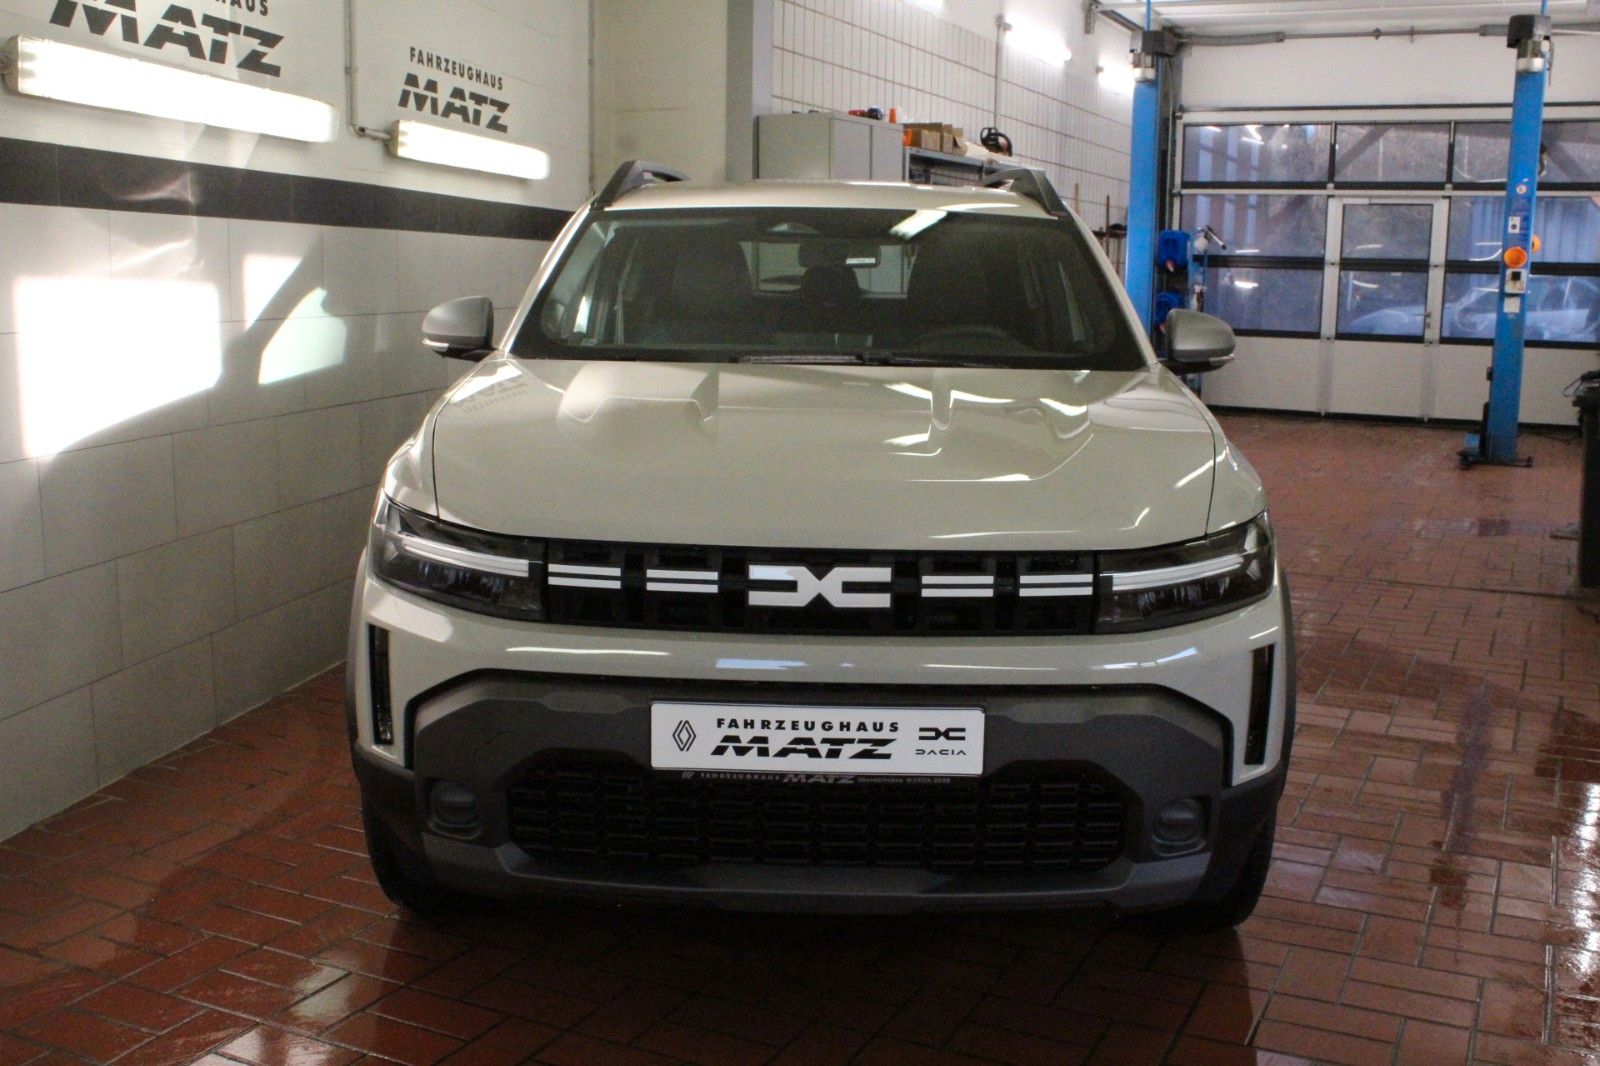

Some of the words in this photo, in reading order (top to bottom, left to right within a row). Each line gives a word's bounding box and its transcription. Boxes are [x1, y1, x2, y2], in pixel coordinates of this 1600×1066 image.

[49, 0, 284, 77] MATZ
[410, 46, 503, 91] FAHRZEUGHAUS
[398, 72, 510, 133] MATZ
[717, 718, 899, 732] FAHRZEUGHAUS
[710, 735, 897, 759] MATZ
[915, 748, 967, 756] DACIA
